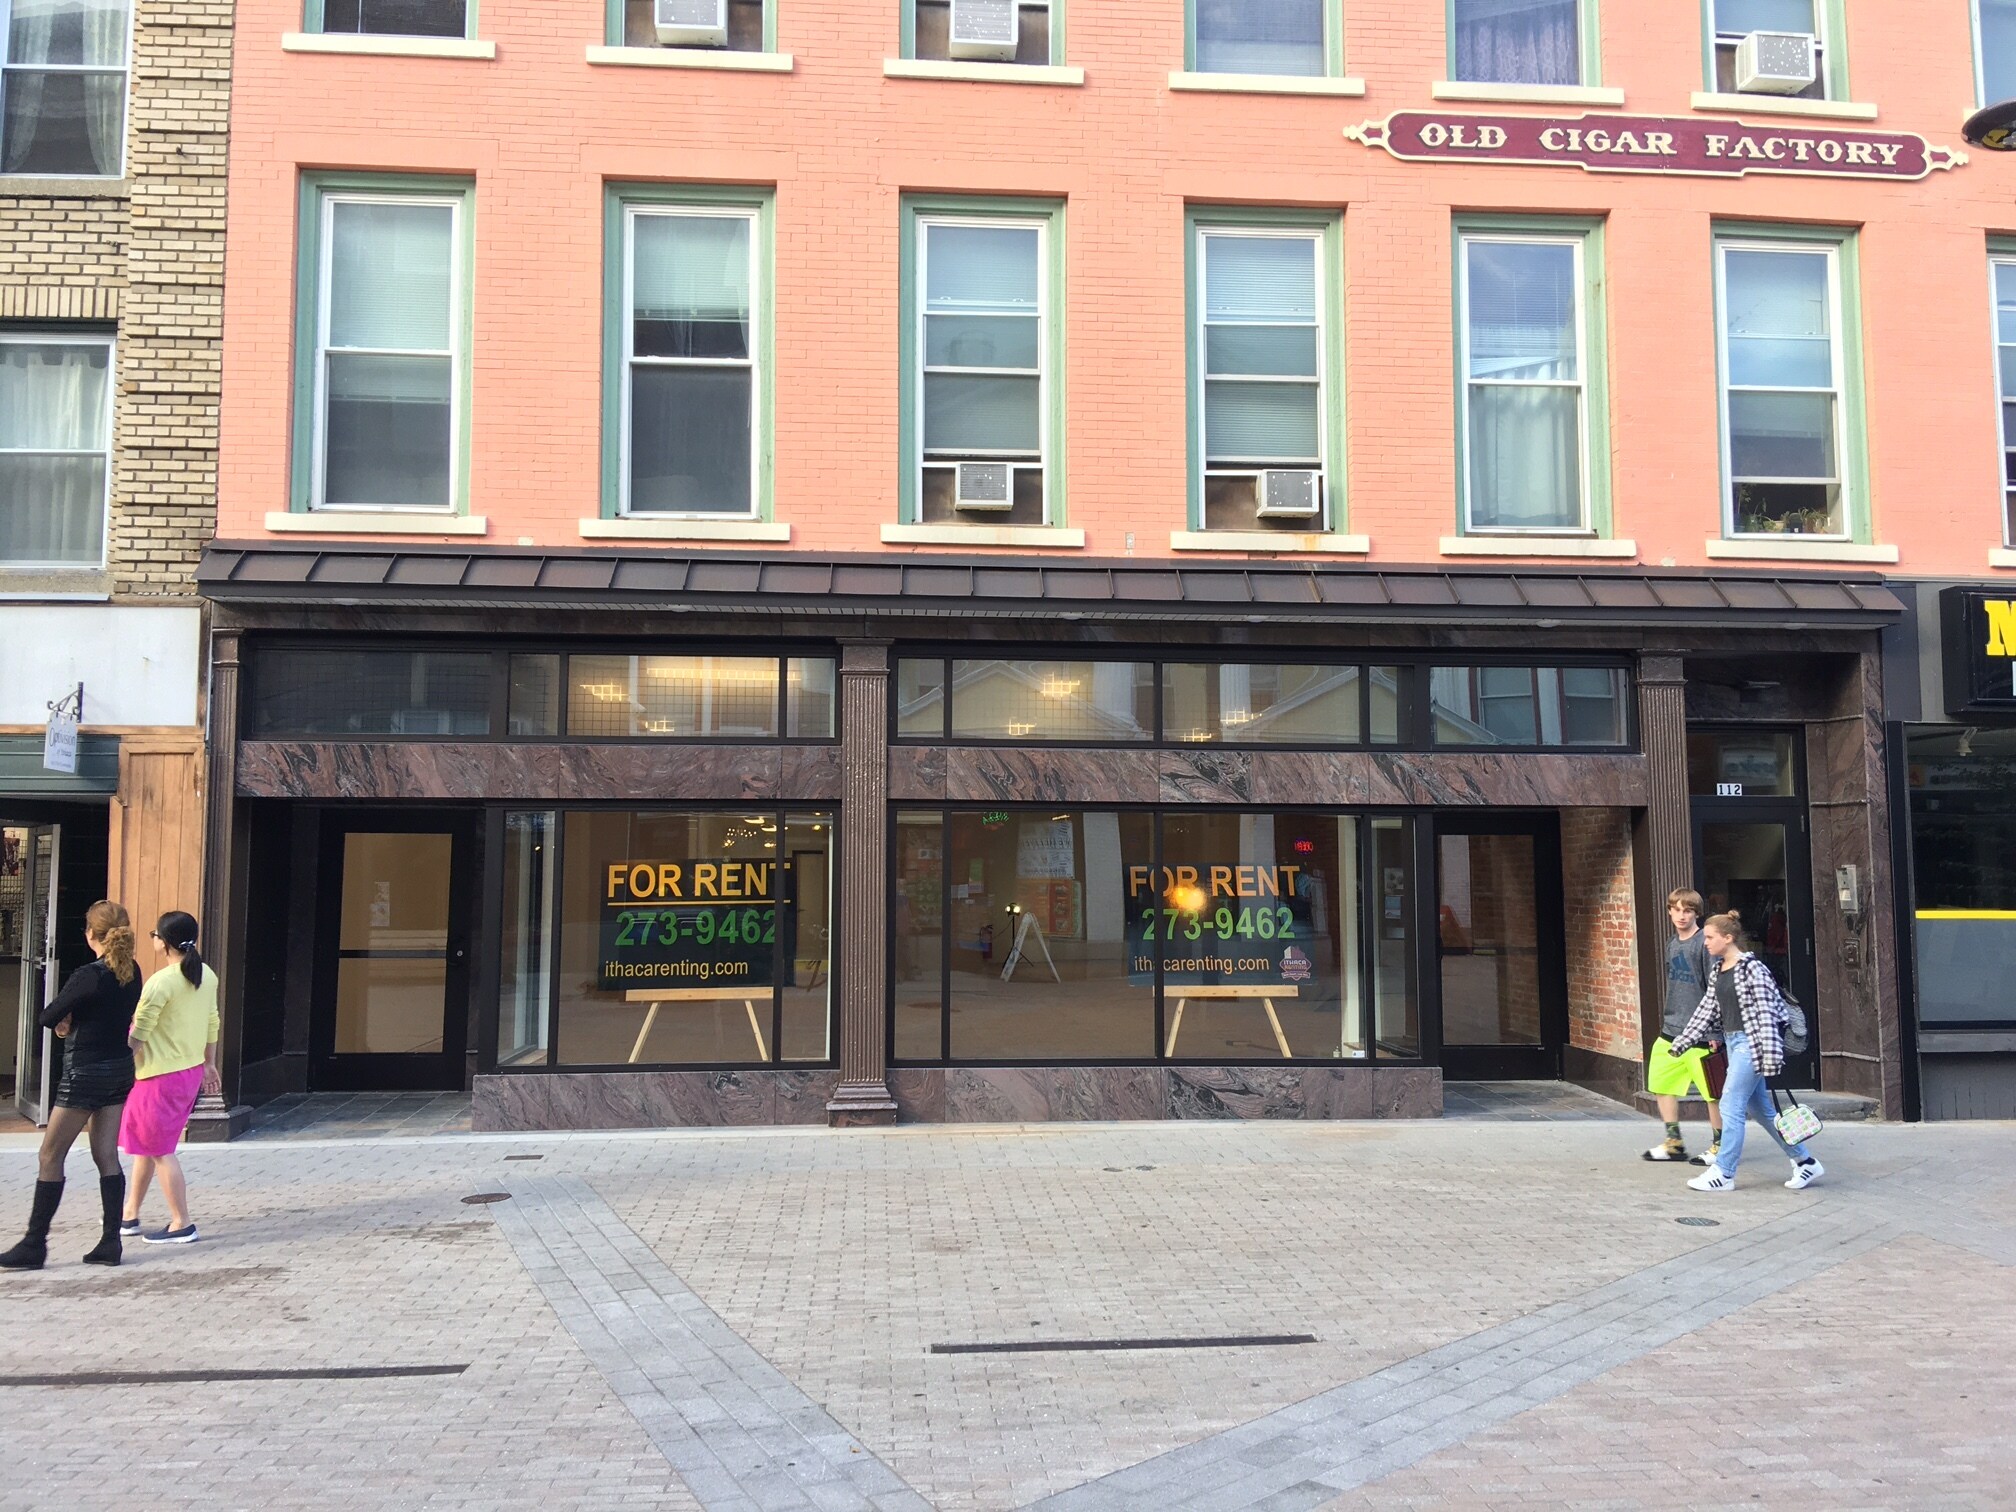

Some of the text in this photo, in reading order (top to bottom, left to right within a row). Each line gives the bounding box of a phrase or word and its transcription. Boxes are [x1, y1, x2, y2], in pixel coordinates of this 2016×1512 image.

[1418, 122, 1904, 166] OLD CIGAR FACTORY
[1718, 784, 1741, 795] 112
[607, 863, 683, 898] FOR
[1210, 865, 1300, 896] RENT
[615, 910, 776, 945] 273-9462
[1141, 907, 1295, 940] 273-9462
[605, 959, 748, 980] ithacarenting.com
[1134, 955, 1270, 975] ithcarenting.com
